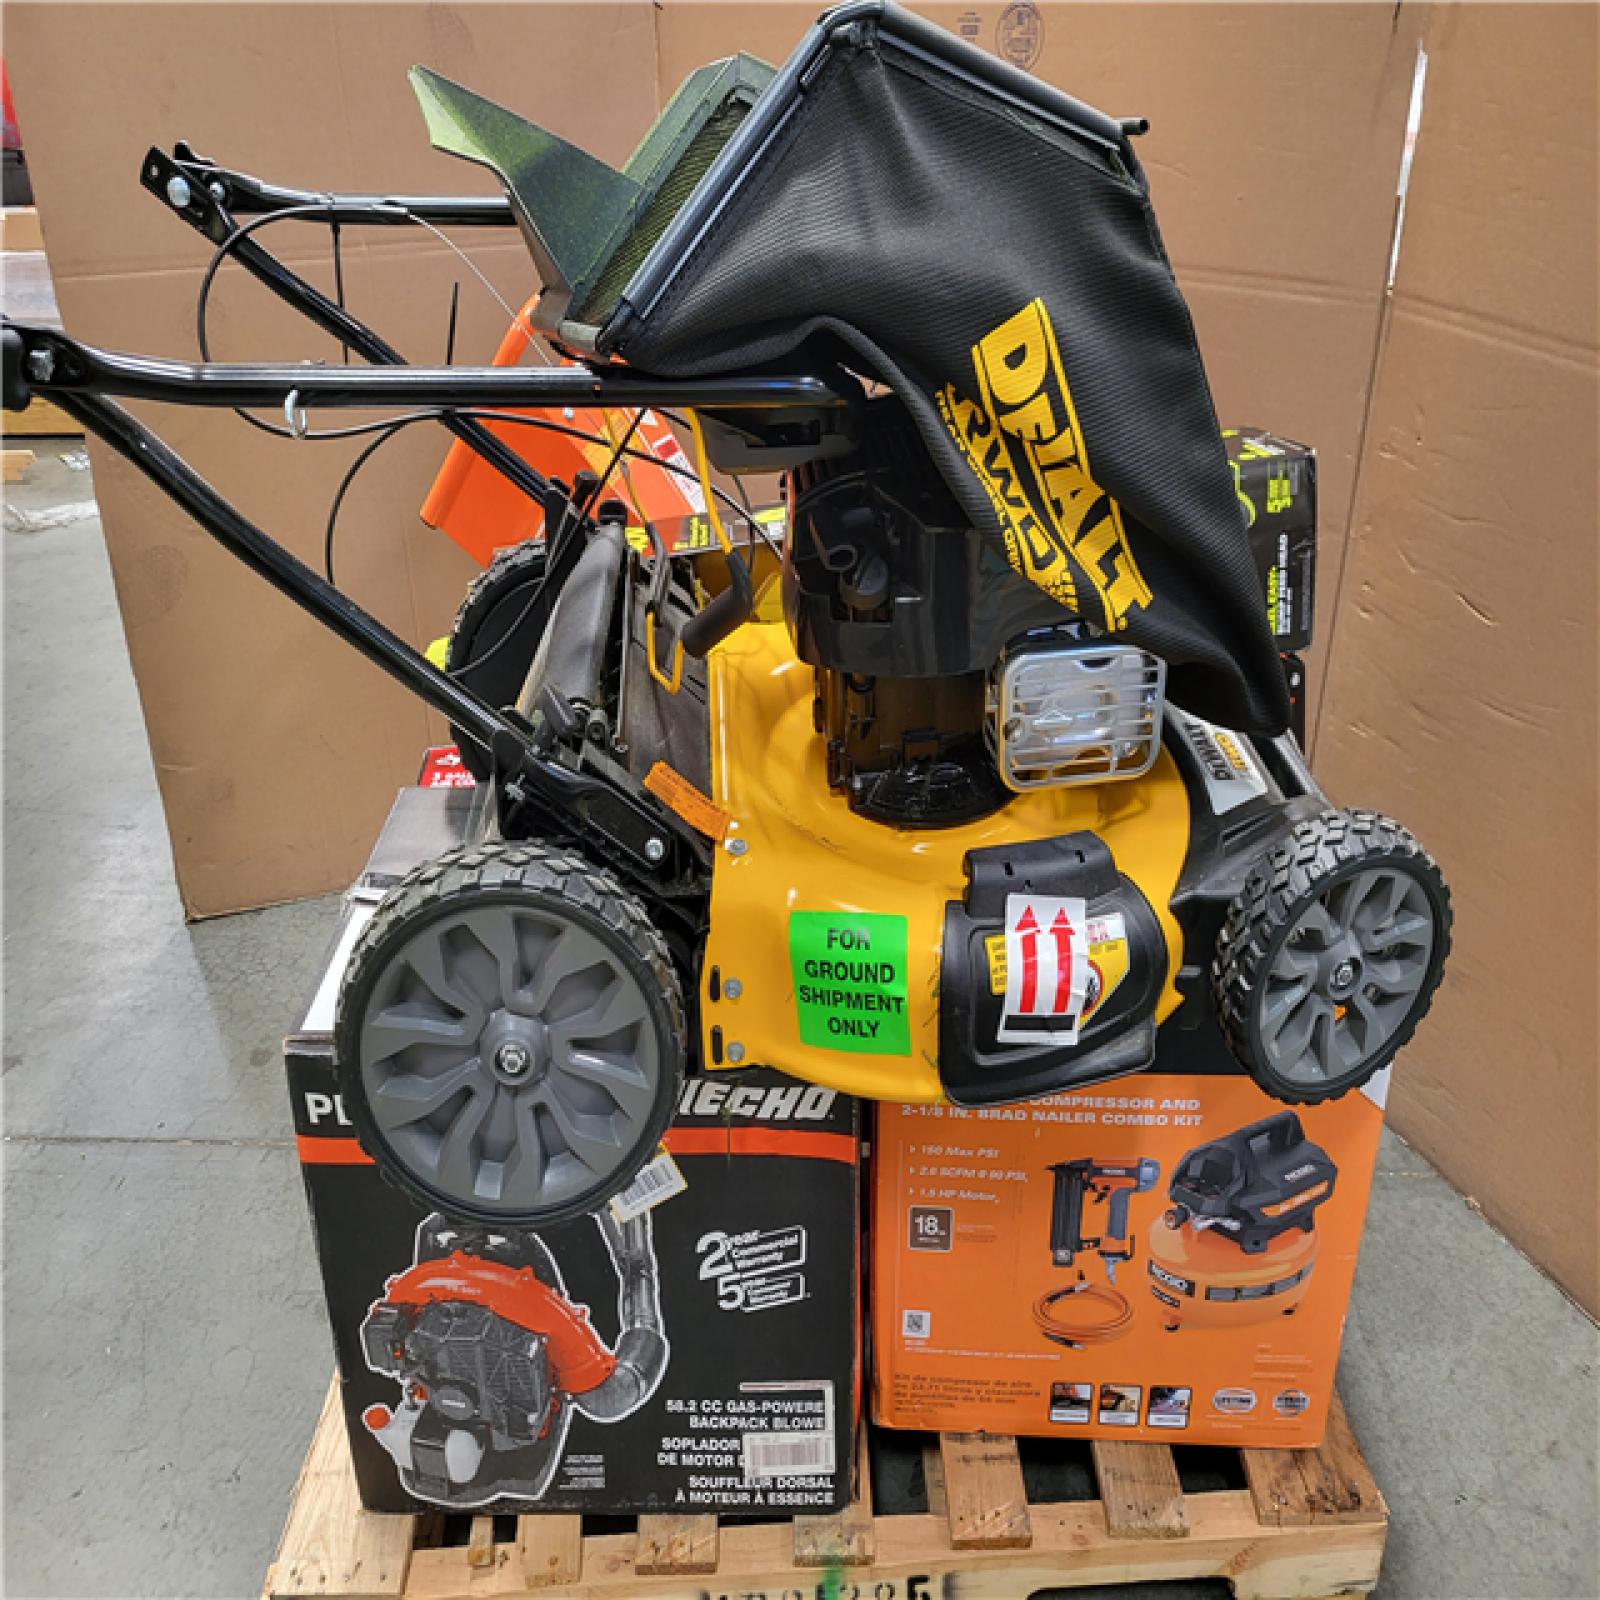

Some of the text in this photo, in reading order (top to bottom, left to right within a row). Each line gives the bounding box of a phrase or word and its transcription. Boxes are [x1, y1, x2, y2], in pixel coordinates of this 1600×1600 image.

[826, 928, 871, 951] FOR
[803, 959, 896, 984] GROUND
[799, 984, 905, 1014] SHIPMENT
[827, 1016, 880, 1038] ONLY
[1028, 1095, 1201, 1111] COMPRESSOR AND
[976, 1108, 1028, 1121] BRAD
[1032, 1110, 1096, 1124] NAILER
[1101, 1113, 1169, 1126] COMBO
[1173, 1114, 1203, 1126] KIT
[914, 1214, 938, 1236] 18
[695, 1231, 734, 1281] 2
[718, 1277, 744, 1310] 5
[700, 1399, 723, 1414] CC
[726, 1400, 826, 1414] GAS-POWERE
[689, 1414, 826, 1430] BACKPACK BLOWE
[661, 1436, 742, 1451] SOPLADOR
[656, 1452, 678, 1467] DE
[680, 1453, 736, 1467] MOTOR
[776, 1476, 836, 1489] DORSAL
[689, 1490, 751, 1504] MOTEUR
[766, 1491, 835, 1505] ESSENCE
